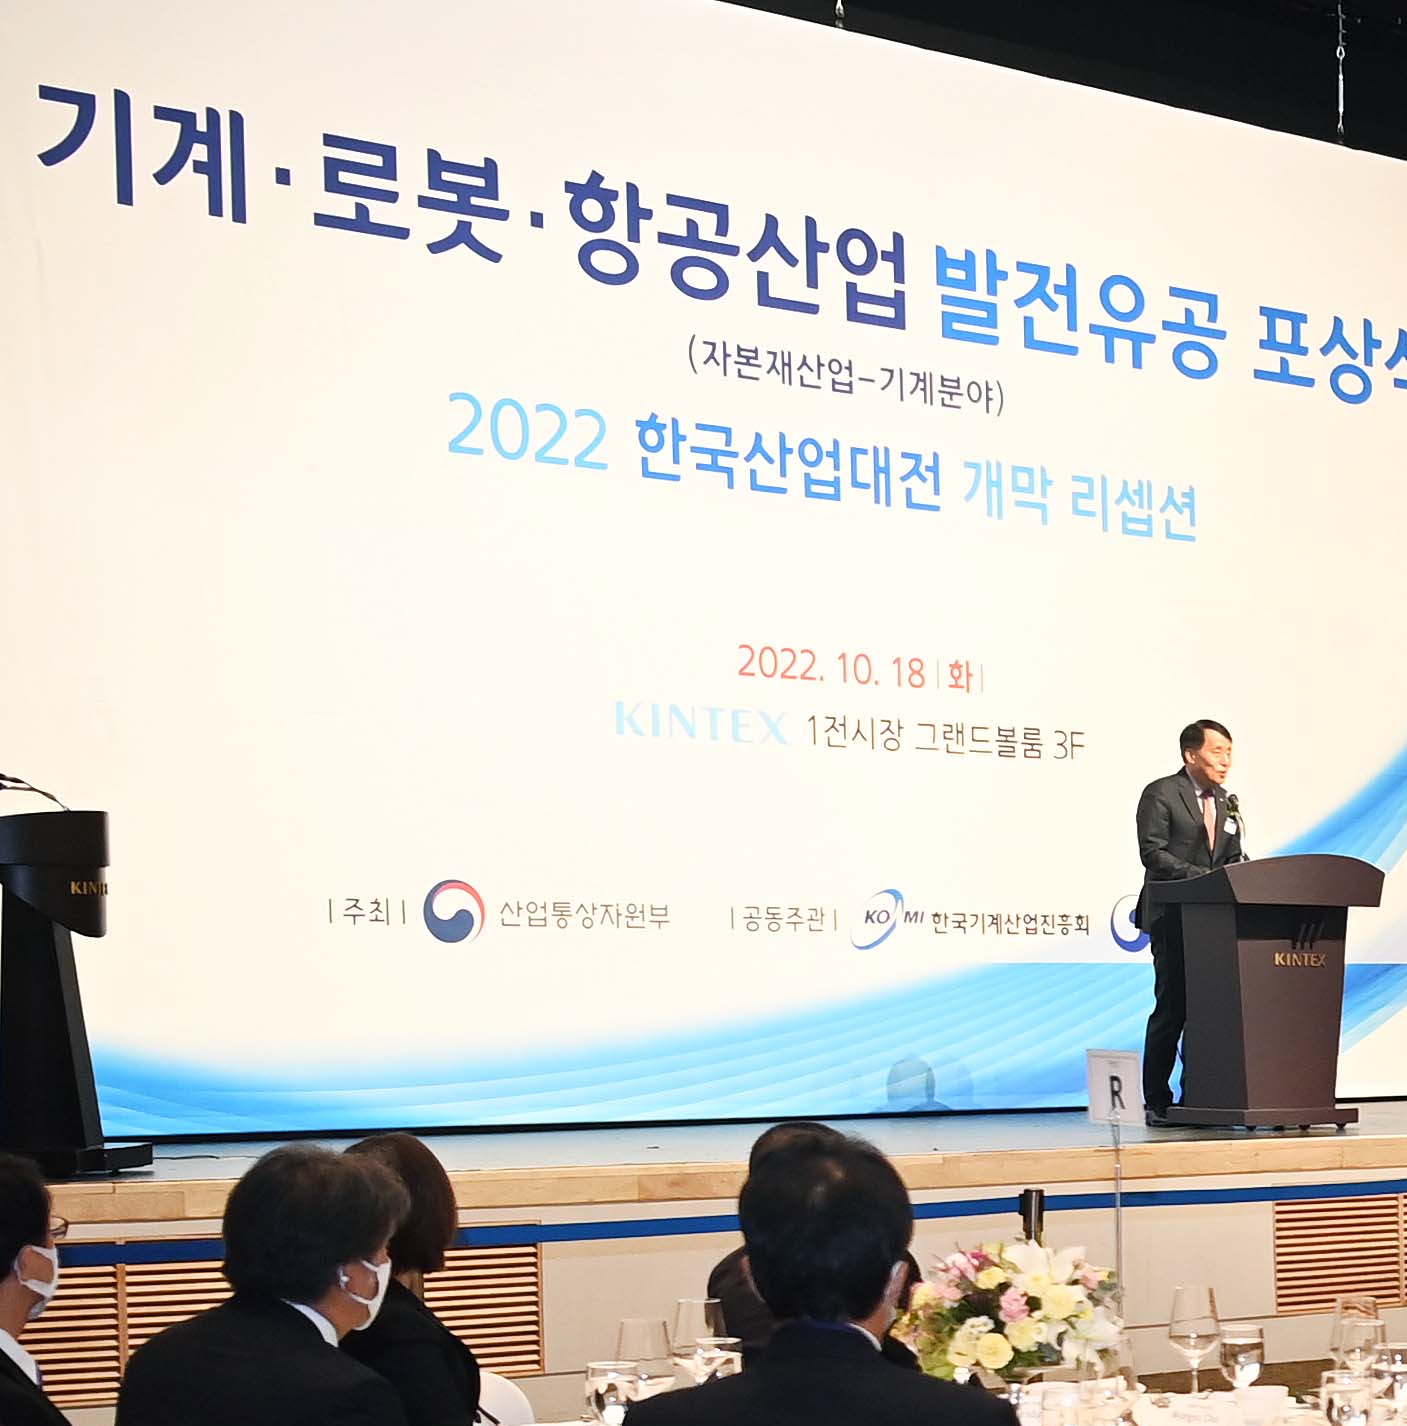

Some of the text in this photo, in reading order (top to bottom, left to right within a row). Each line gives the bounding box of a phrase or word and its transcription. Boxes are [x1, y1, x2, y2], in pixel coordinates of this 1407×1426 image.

[936, 245, 1227, 380] 발전유공
[689, 333, 1003, 416] (자본재산업-기계분야)
[448, 392, 1196, 543] 2022 한국산업대전 개막 리셉션
[616, 700, 1085, 759] KINTEX 1전시장 그랜드볼룸 3F
[500, 901, 670, 929] 산업통상자원부
[931, 912, 1089, 936] 한국기계산업진흥회
[1275, 952, 1325, 968] KINTEX
[1109, 1075, 1126, 1111] R
